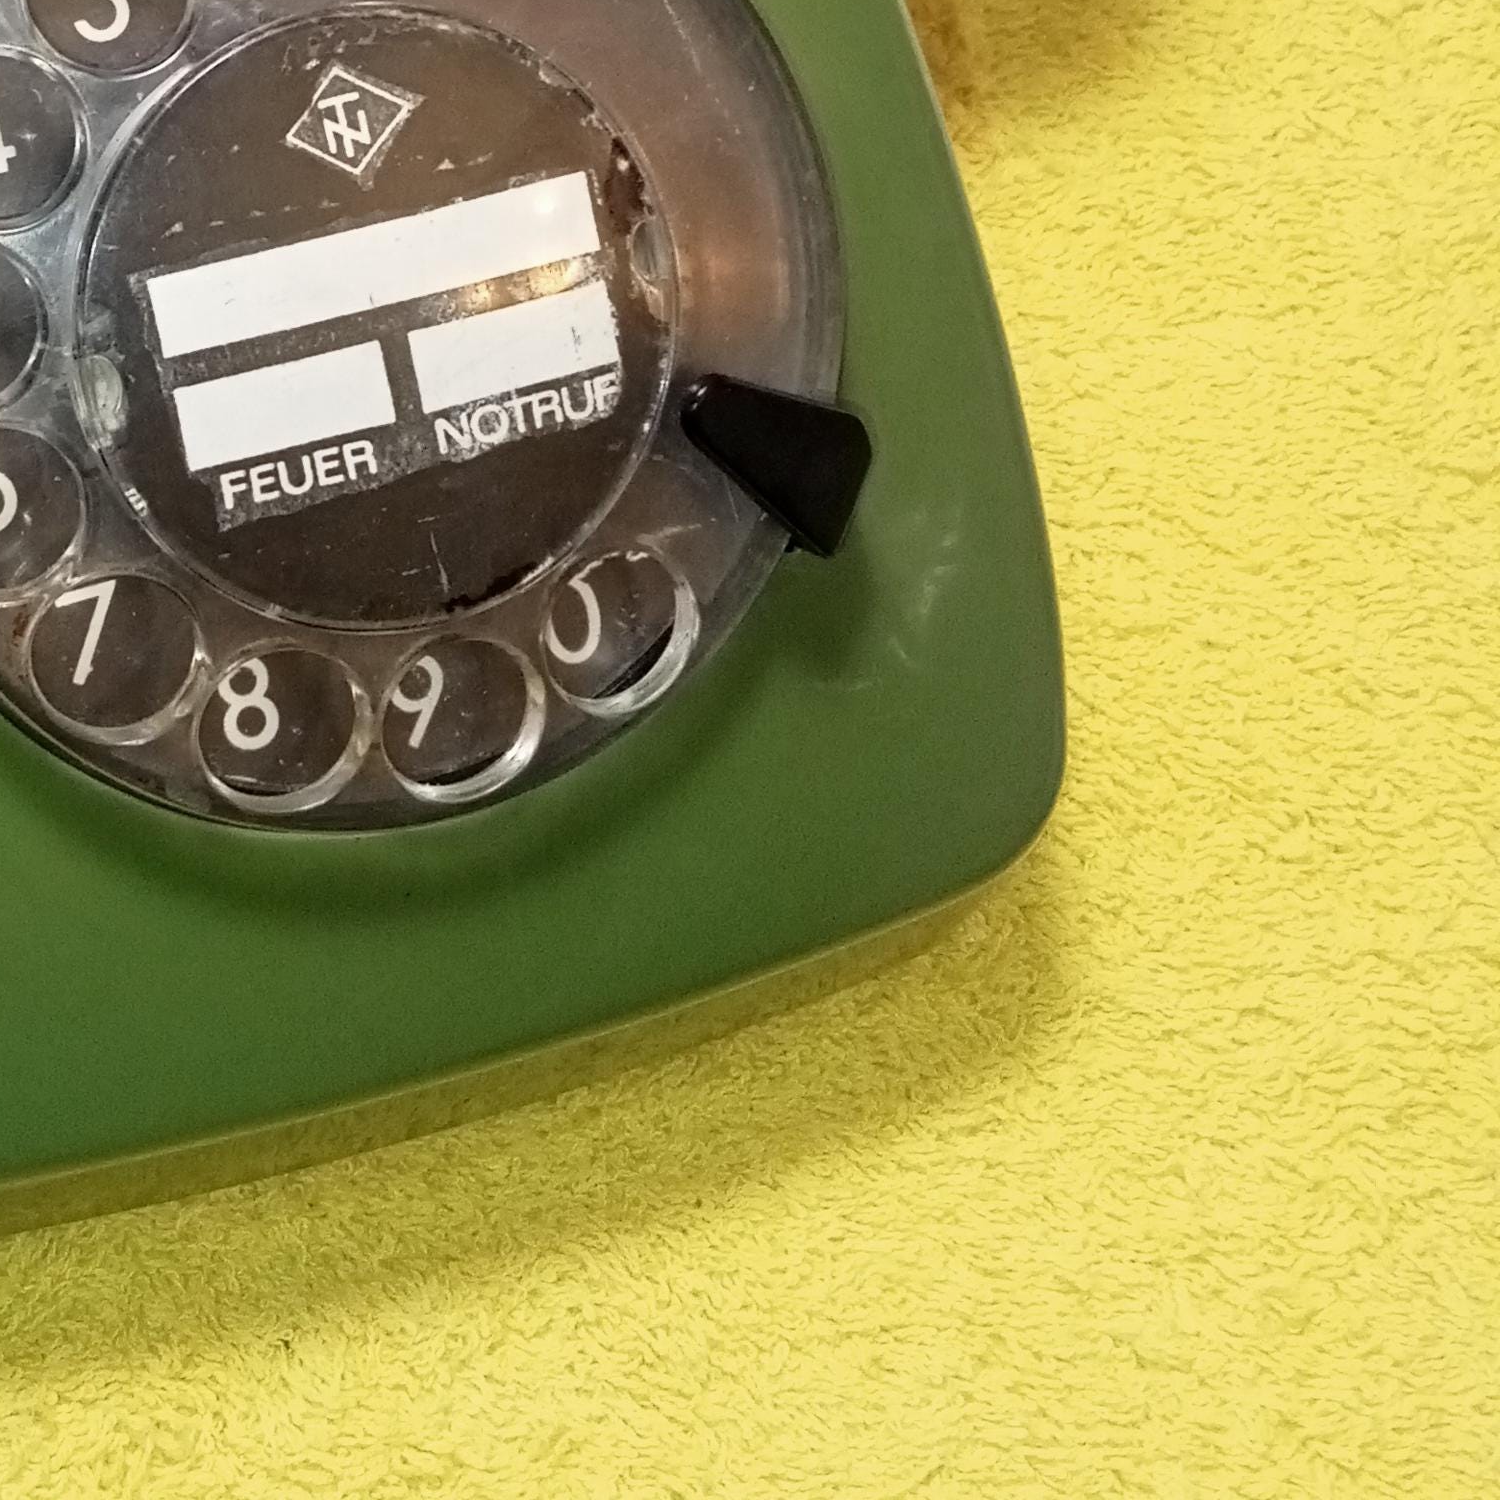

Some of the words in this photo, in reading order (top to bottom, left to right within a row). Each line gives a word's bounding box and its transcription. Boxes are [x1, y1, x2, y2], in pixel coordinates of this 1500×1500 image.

[218, 439, 378, 510] FEUER
[433, 372, 620, 455] NOTRUF
[54, 579, 117, 686] 7
[217, 656, 280, 751] 8
[391, 654, 445, 749] 9
